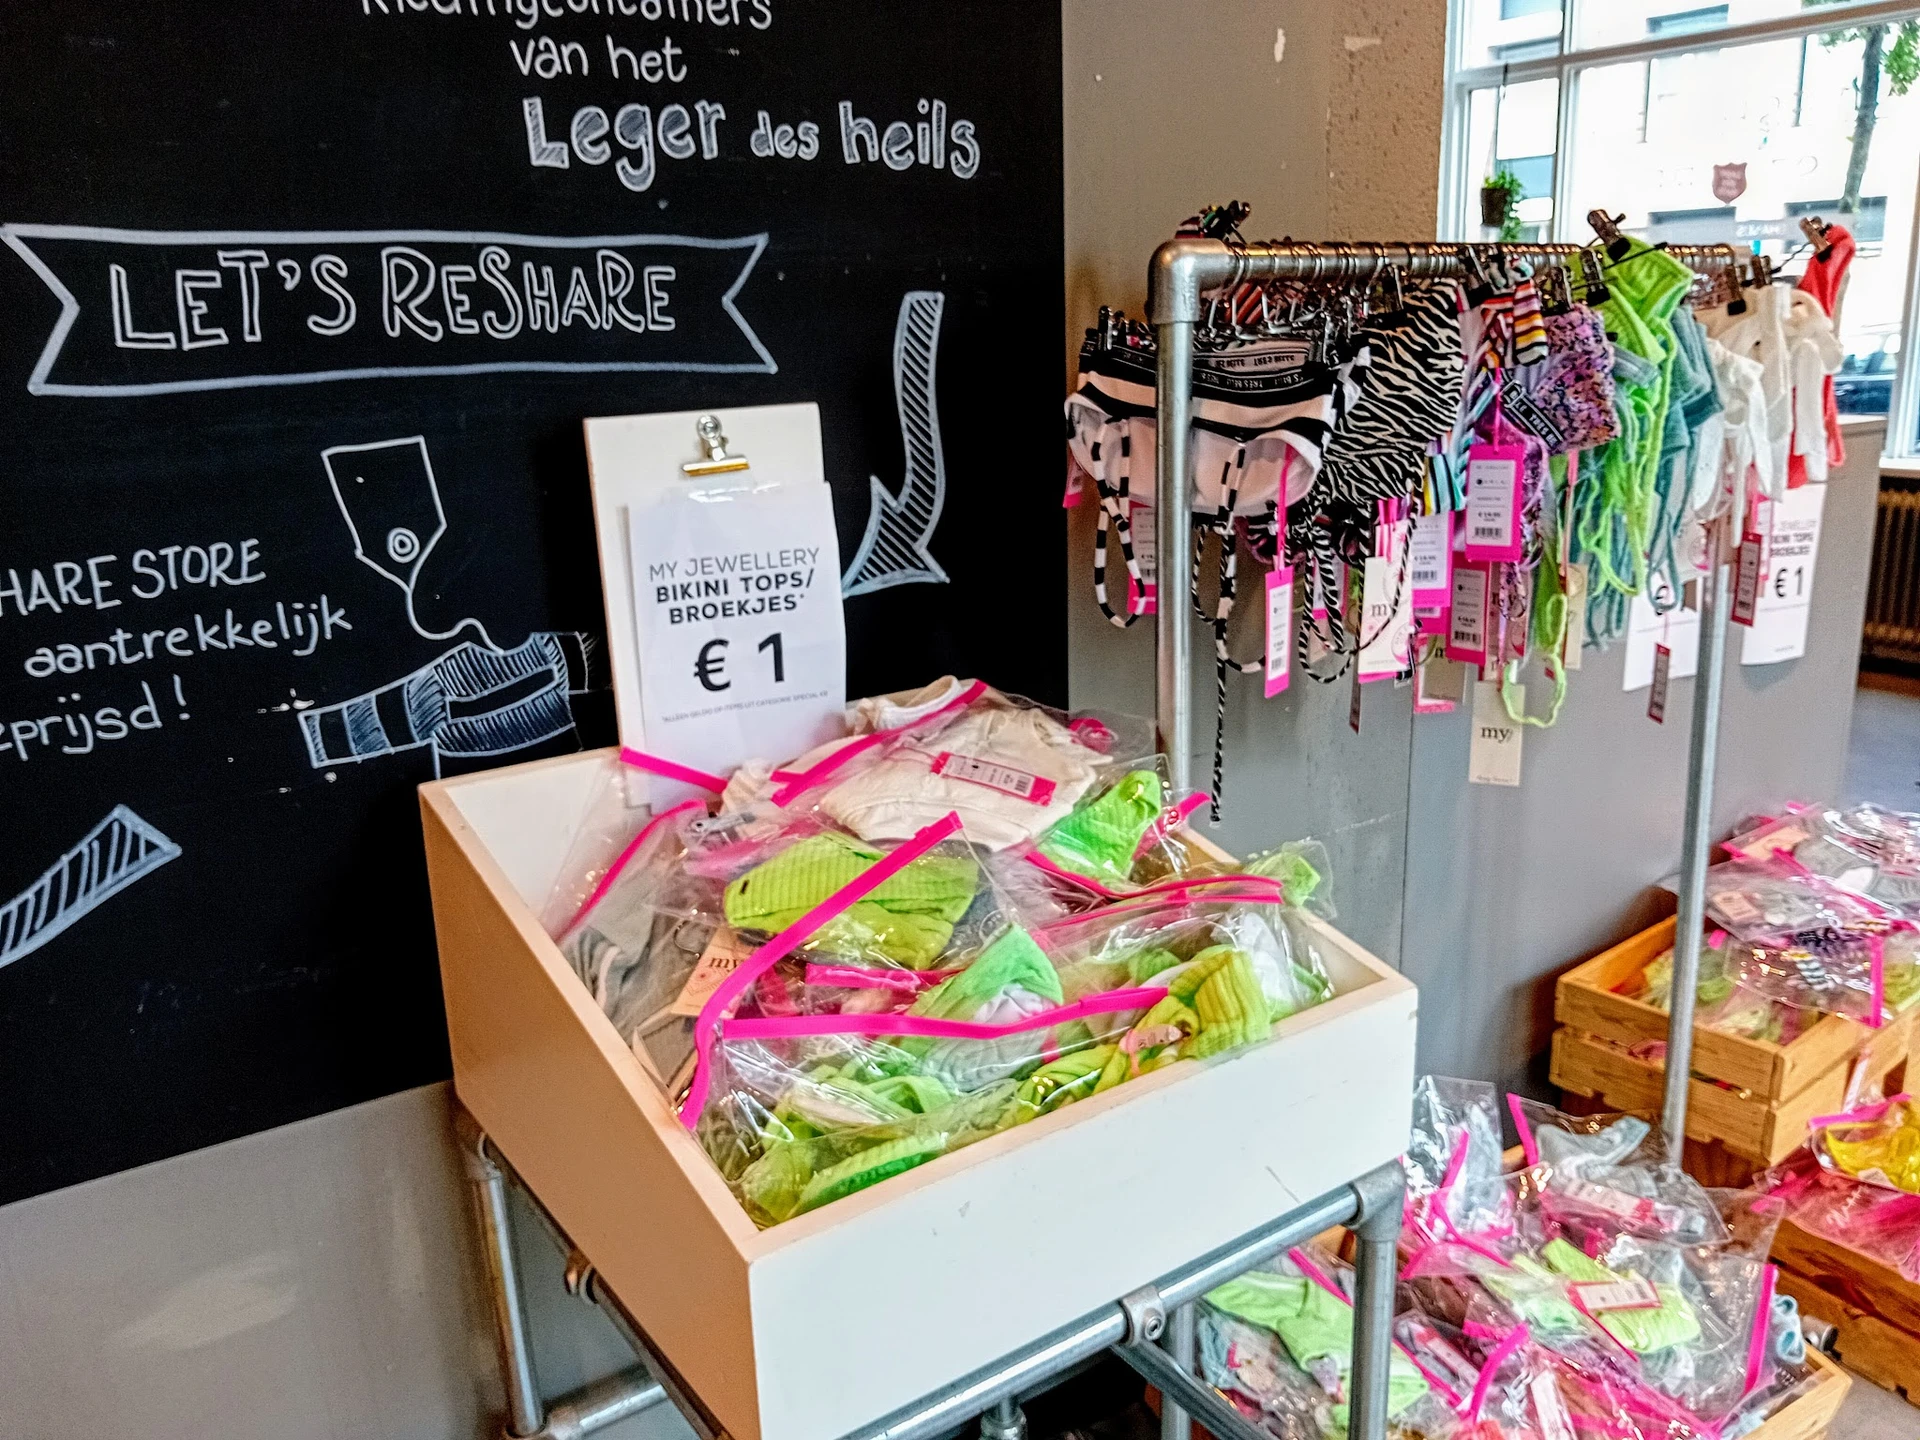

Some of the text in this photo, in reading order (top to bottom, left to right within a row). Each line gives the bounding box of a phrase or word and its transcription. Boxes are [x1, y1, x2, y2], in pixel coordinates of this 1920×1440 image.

[510, 35, 687, 83] van het
[523, 97, 981, 192] Leger des heils
[109, 245, 676, 351] LET'S RESHARE
[131, 538, 266, 599] STORE
[649, 547, 820, 582] MY JEWELLERY
[656, 568, 815, 604] BIKINI TOPS/
[1774, 566, 1803, 598] € 1
[24, 594, 353, 677] aantrekkelijk
[693, 632, 785, 692] € 1
